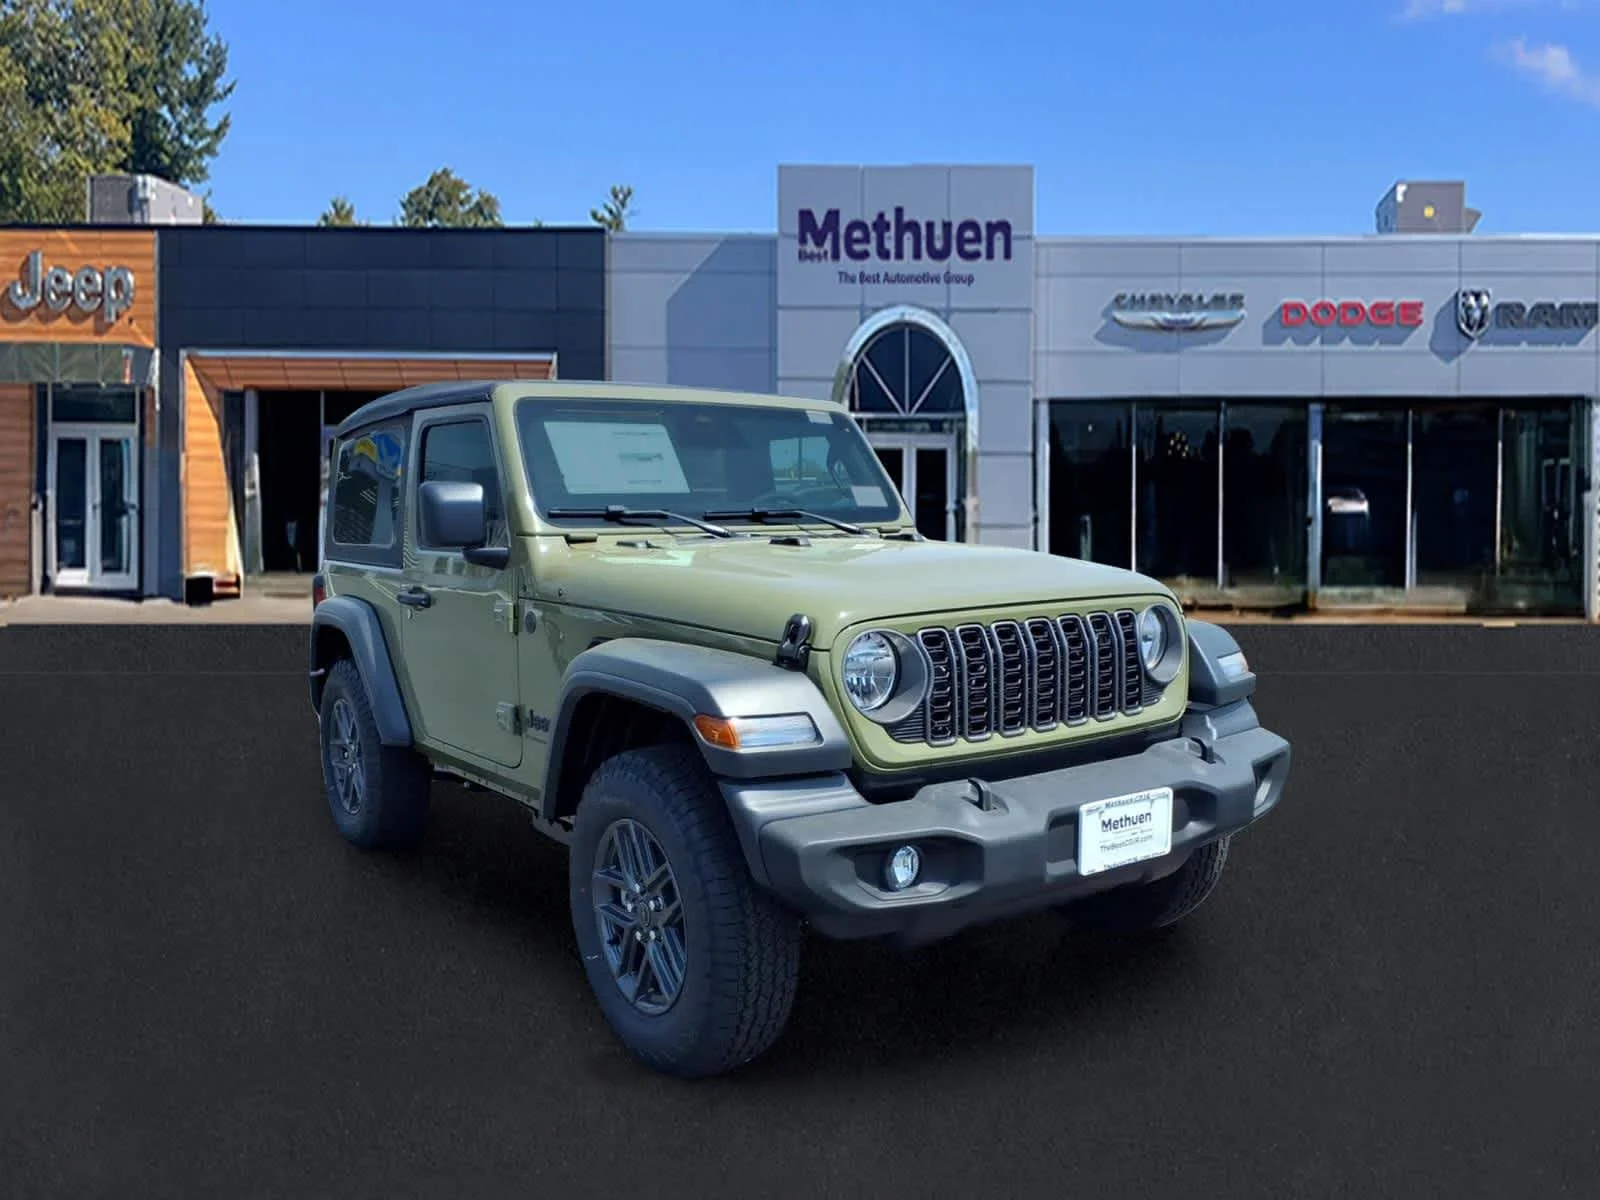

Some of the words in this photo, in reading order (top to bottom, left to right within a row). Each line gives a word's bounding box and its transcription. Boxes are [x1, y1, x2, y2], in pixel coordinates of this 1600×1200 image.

[798, 206, 1012, 262] Methuen
[798, 248, 829, 262] Best
[9, 249, 135, 323] Jeep
[838, 271, 857, 284] The
[859, 271, 880, 284] Best
[883, 271, 941, 284] Automotive
[943, 271, 975, 287] Group
[1114, 293, 1244, 309] CHRYSLER
[1282, 301, 1424, 327] DODGE
[1495, 302, 1599, 328] RAM
[1101, 812, 1152, 832] Methuen
